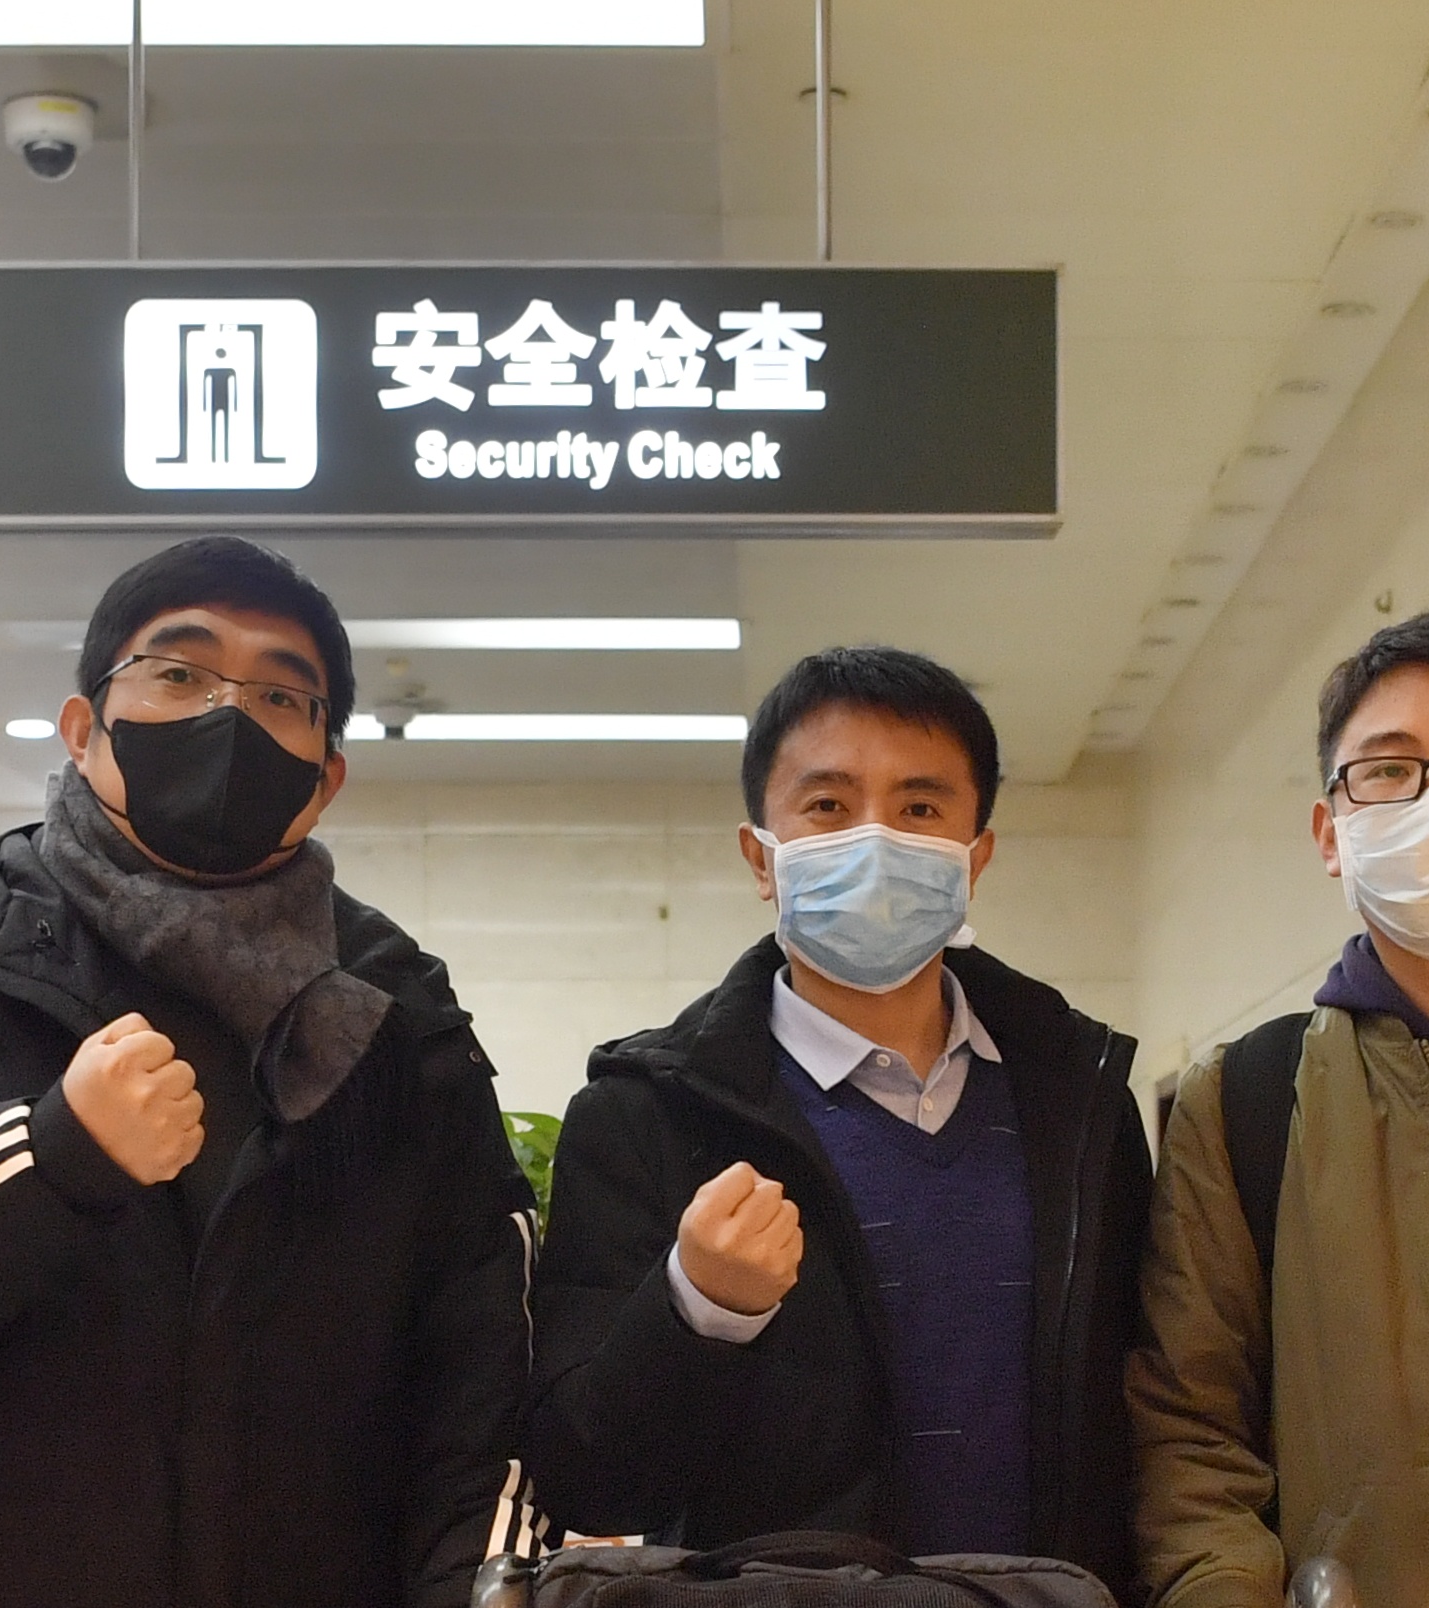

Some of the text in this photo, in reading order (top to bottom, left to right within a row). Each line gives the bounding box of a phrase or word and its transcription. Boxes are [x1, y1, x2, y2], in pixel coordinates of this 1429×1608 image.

[371, 298, 828, 412] 安全检查
[414, 429, 782, 491] Security Check
